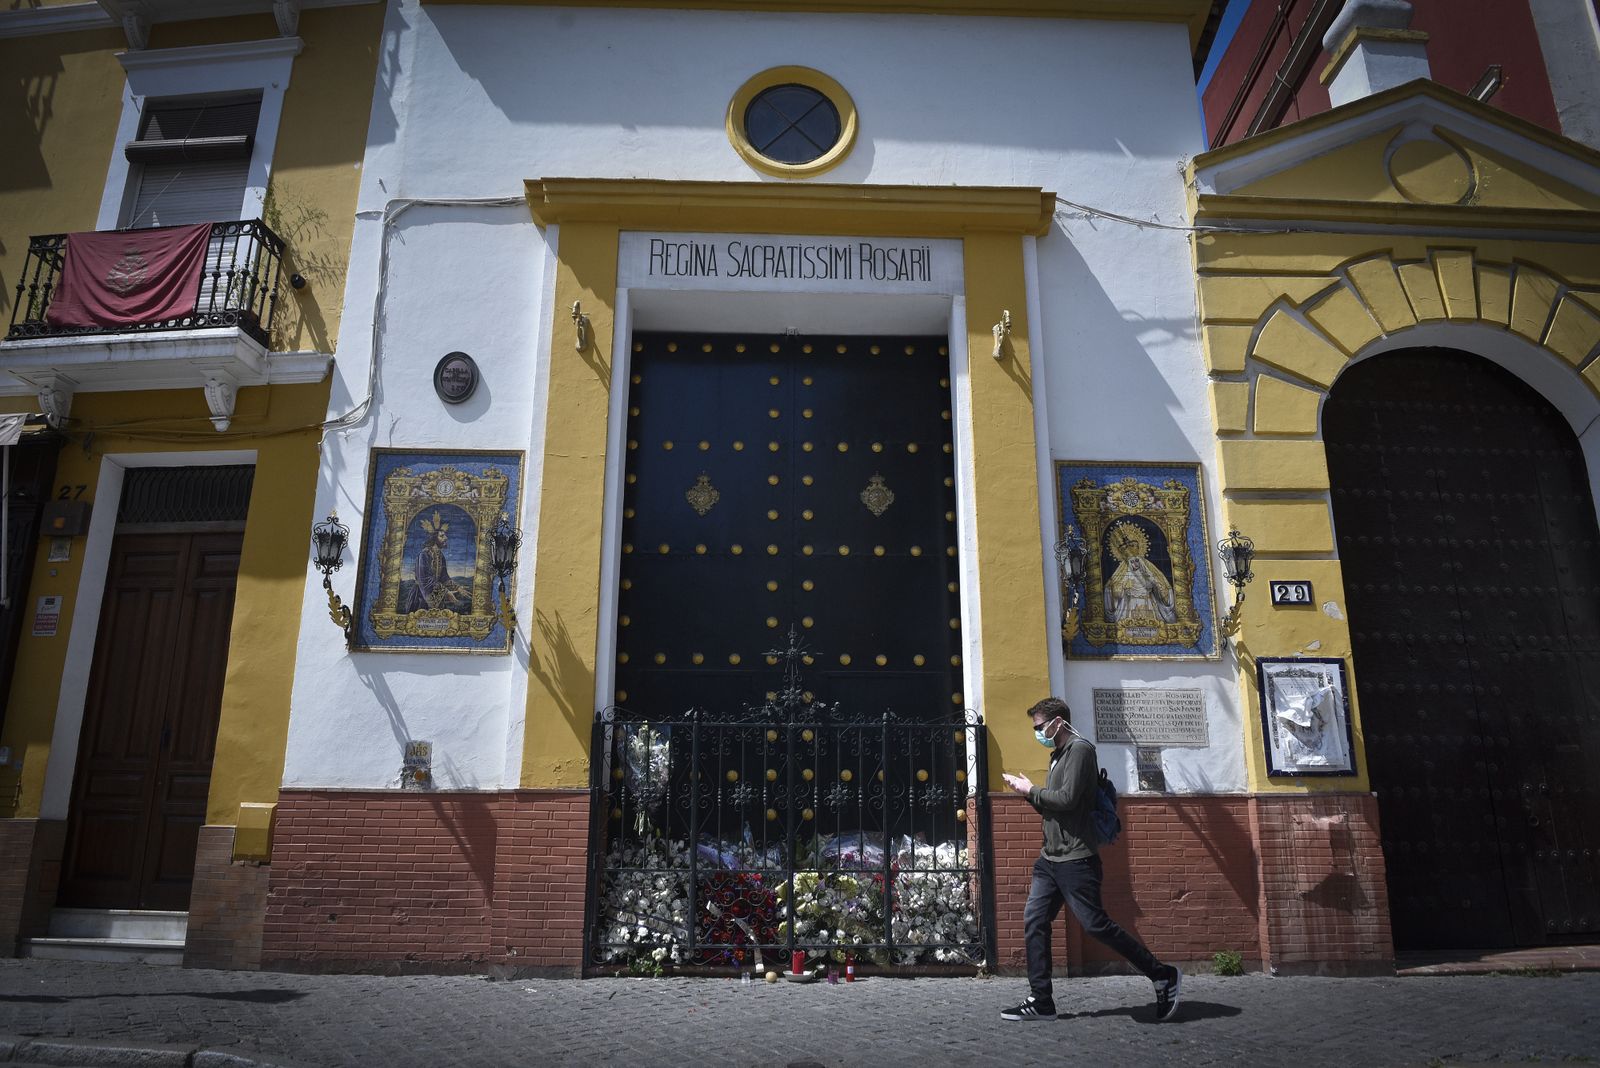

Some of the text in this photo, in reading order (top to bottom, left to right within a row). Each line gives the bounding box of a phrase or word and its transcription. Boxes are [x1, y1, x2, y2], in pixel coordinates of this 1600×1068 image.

[649, 238, 932, 282] REGINA SACRATISSIMI ROSARII
[59, 484, 88, 500] 27
[1277, 585, 1306, 601] 29
